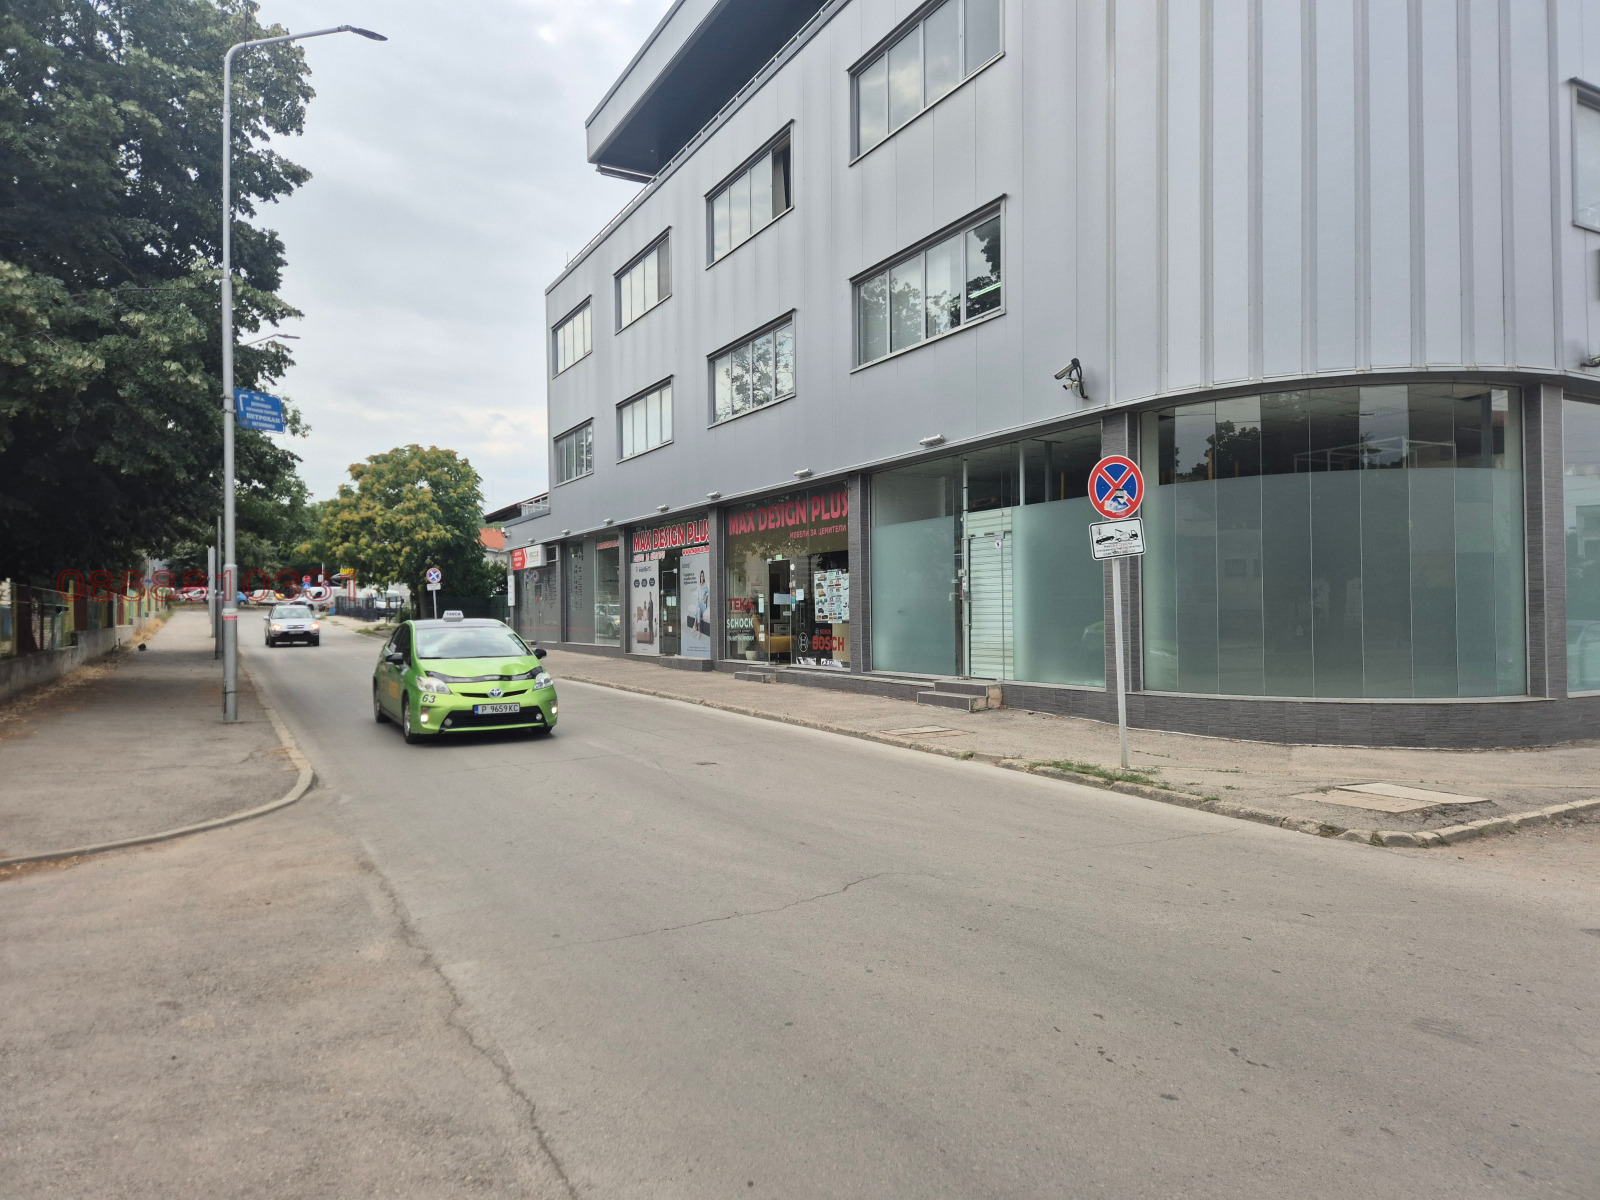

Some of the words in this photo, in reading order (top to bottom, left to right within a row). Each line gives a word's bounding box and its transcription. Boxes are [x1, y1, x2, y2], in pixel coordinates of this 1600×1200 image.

[728, 508, 756, 536] MAX
[758, 498, 808, 532] DESIGN
[811, 490, 849, 522] PLUS
[633, 530, 652, 553] MAX
[653, 522, 685, 550] DESIGN
[810, 528, 817, 537] ЗА
[818, 524, 847, 536] ЦЕНИТЕЛИ
[728, 597, 755, 611] TEKA
[726, 617, 754, 629] SCHOCK
[812, 636, 845, 651] BOSCH
[422, 694, 436, 703] 63
